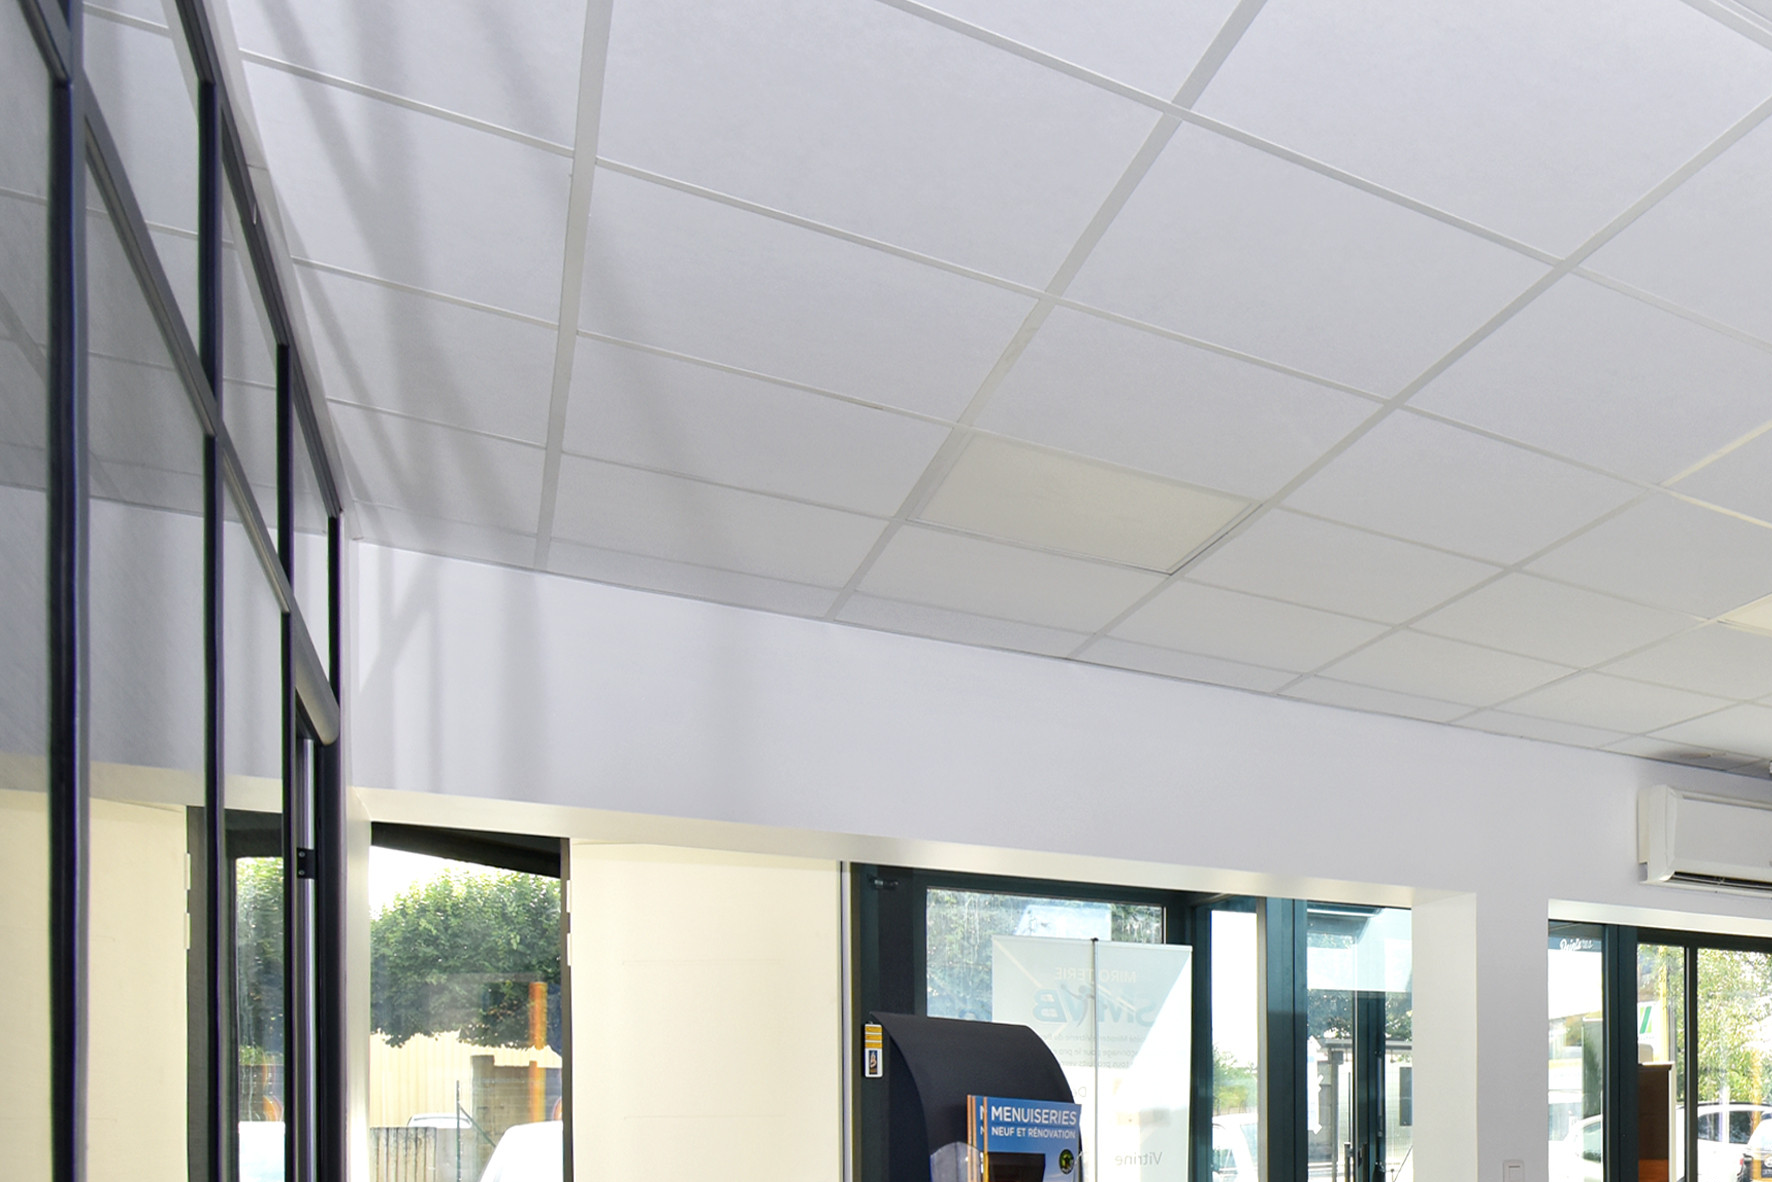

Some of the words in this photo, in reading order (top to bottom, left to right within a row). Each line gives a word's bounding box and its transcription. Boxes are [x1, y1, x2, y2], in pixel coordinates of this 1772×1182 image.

[991, 1105, 1077, 1126] MENUISERIES
[991, 1126, 1014, 1136] NEUF
[1016, 1126, 1026, 1137] ET
[1028, 1127, 1076, 1139] RÉNOVATION
